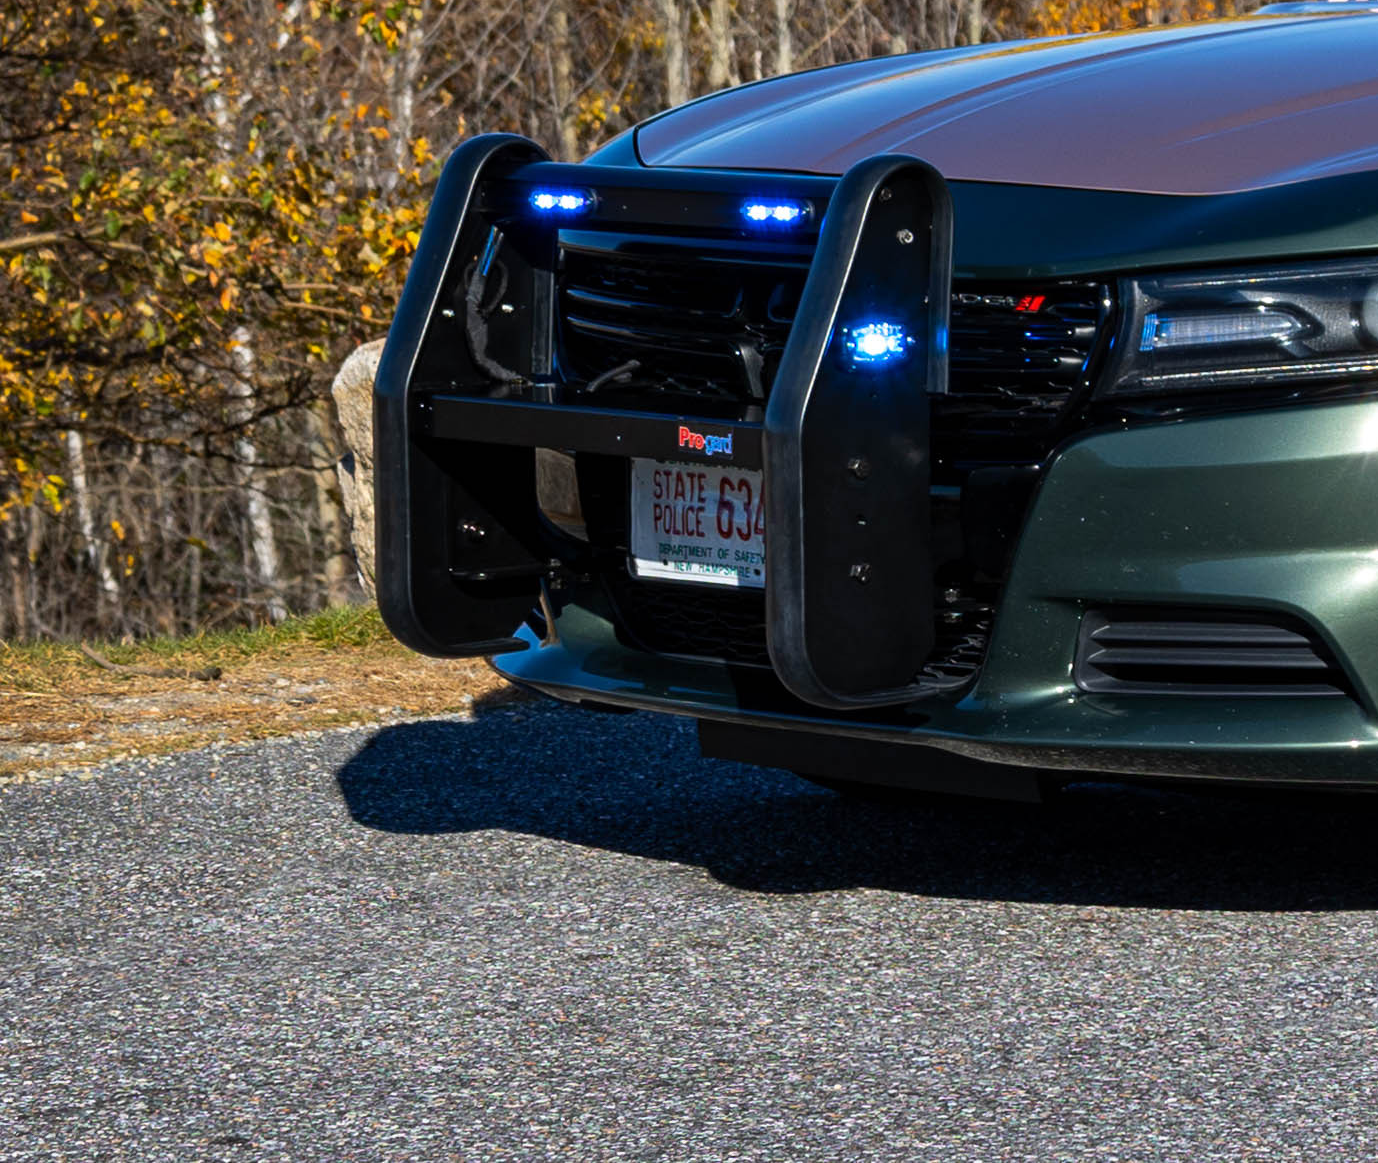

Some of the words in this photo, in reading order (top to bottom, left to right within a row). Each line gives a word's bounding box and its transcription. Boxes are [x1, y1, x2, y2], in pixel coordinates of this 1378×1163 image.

[653, 469, 706, 504] STATE
[653, 503, 706, 538] POLICE
[658, 542, 713, 559] DEPARTMENT
[716, 547, 729, 560] OF
[673, 559, 693, 573] NEW
[698, 562, 751, 579] HAMPSHIRE
